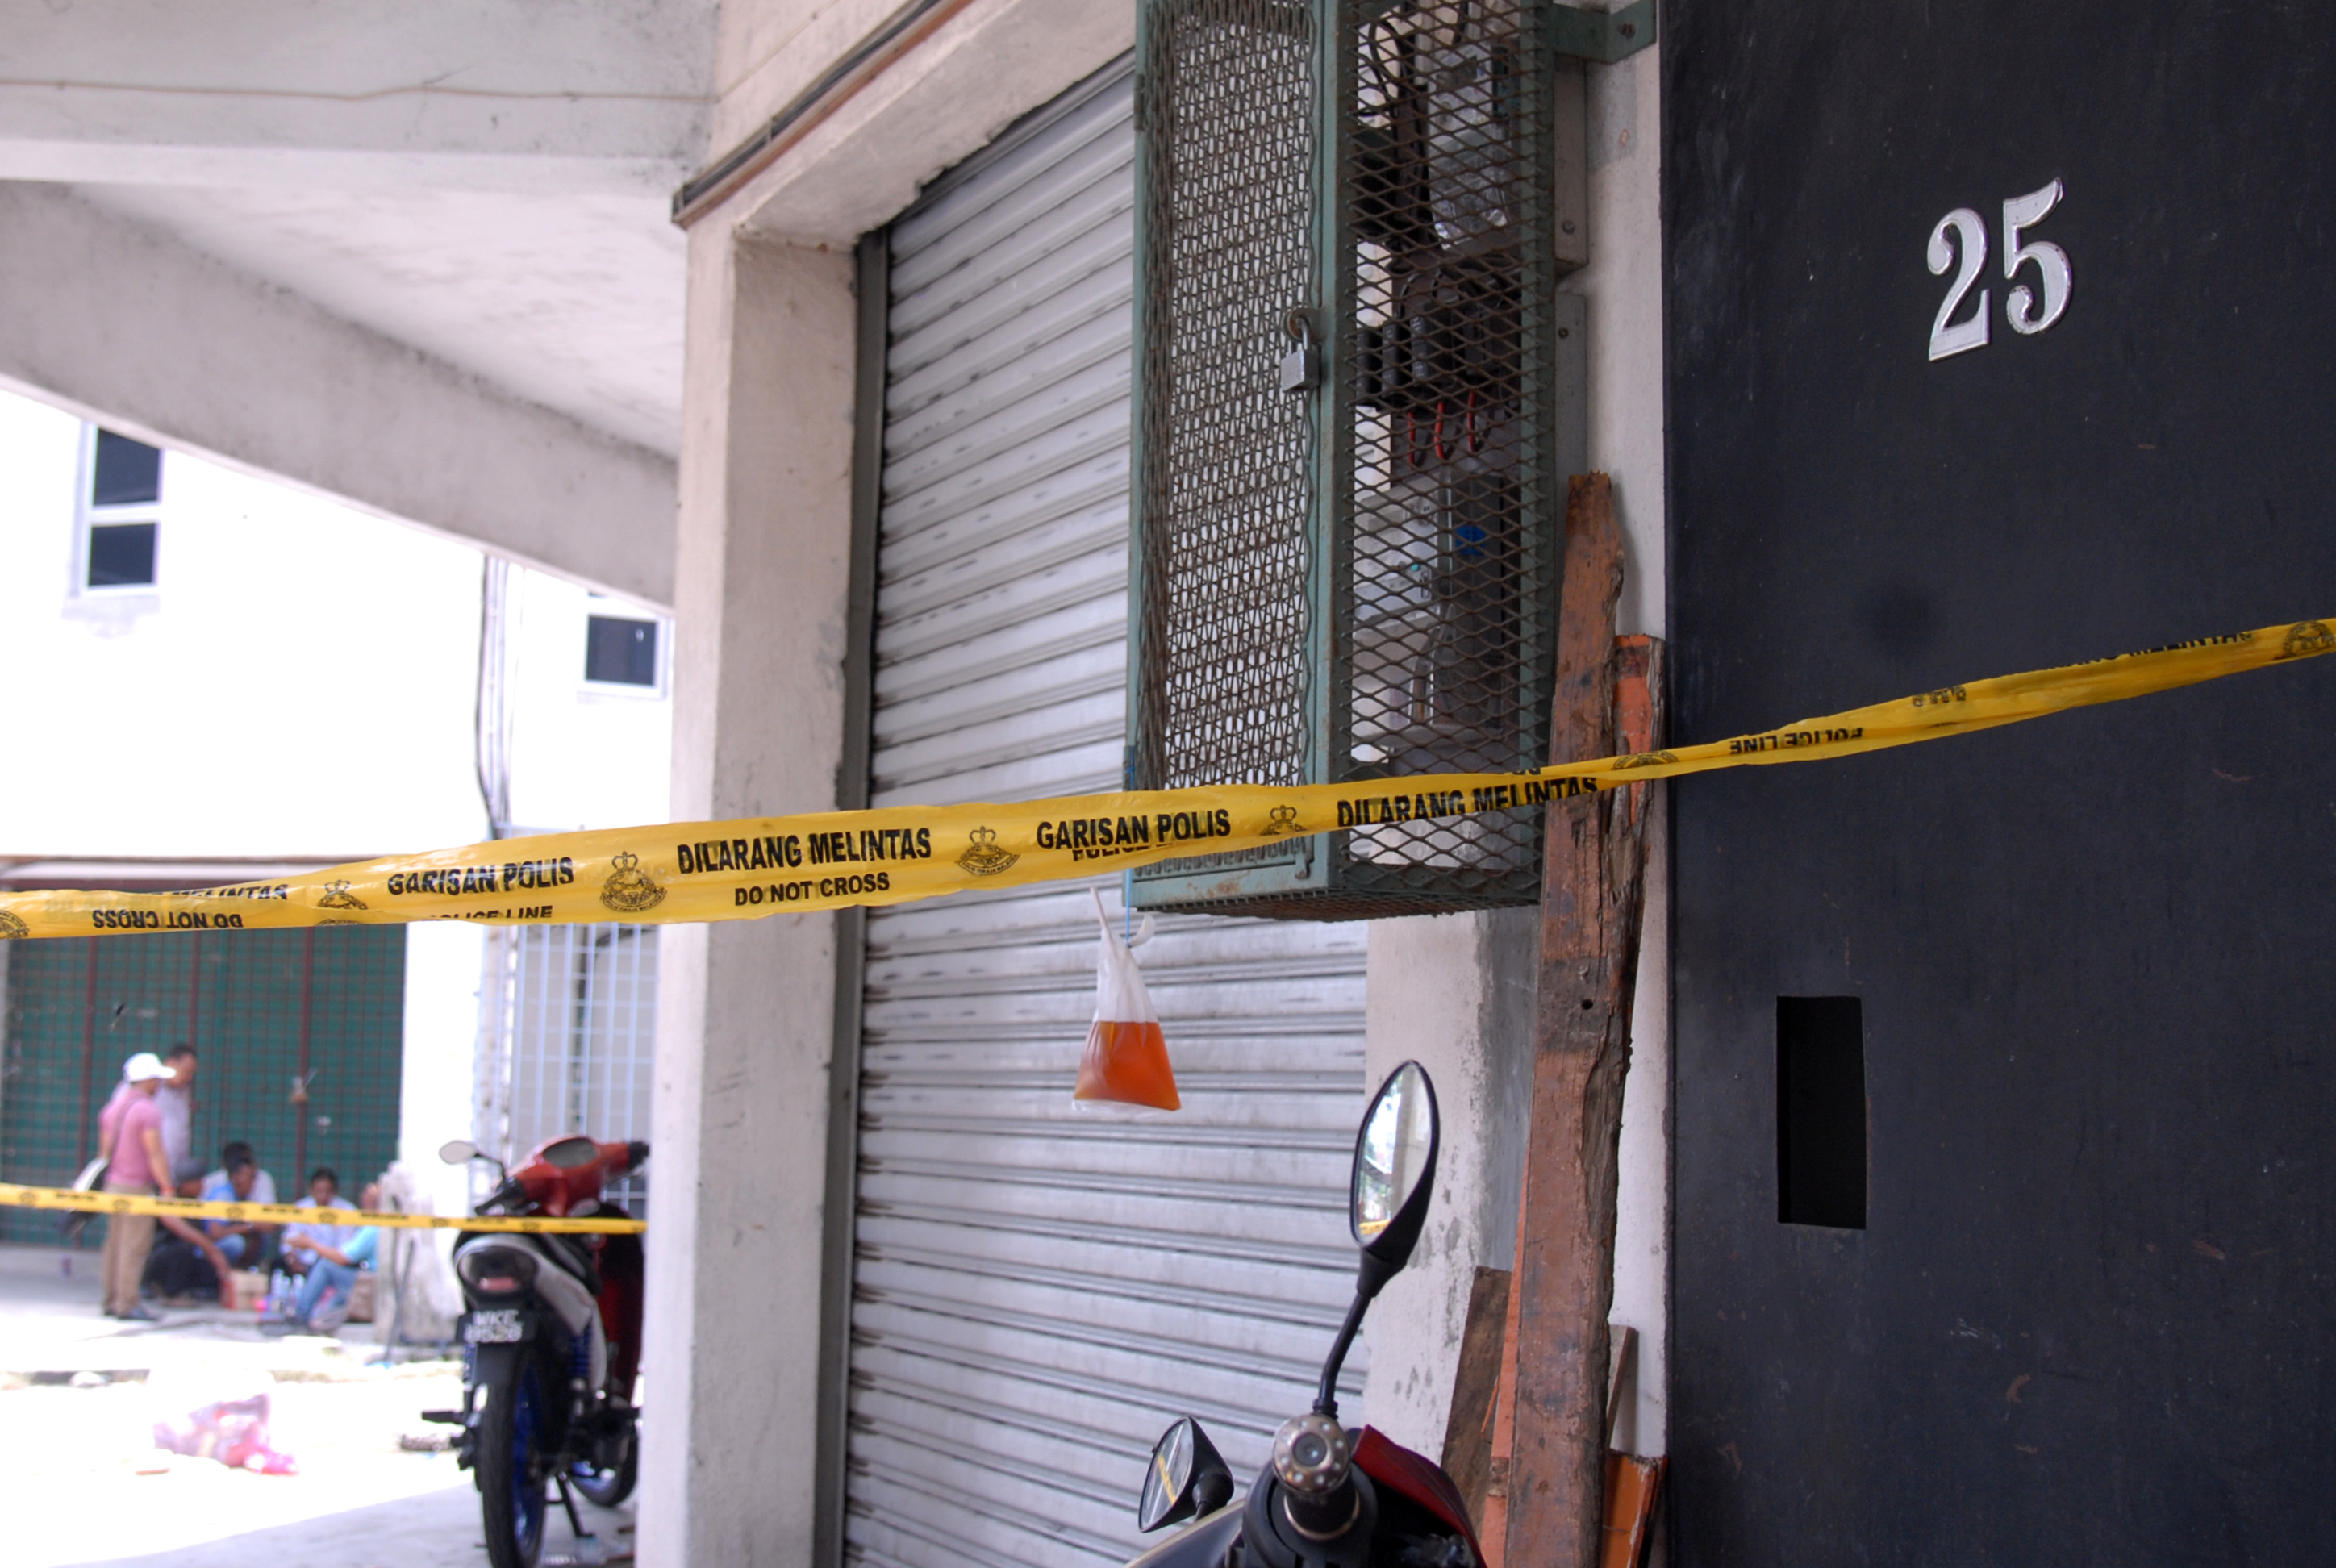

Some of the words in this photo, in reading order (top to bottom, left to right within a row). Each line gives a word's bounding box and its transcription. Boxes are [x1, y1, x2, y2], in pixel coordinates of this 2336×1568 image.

[1927, 177, 2072, 361] 25
[1729, 735, 1778, 755] LINE
[1337, 790, 1466, 828] DILARANG
[1037, 814, 1149, 849] GARISAN
[1157, 807, 1232, 842] POLIS
[677, 834, 801, 874] DILARANG
[807, 827, 932, 865] MELINTAS
[387, 865, 496, 896] GARISAN
[503, 856, 574, 892] POLIS
[734, 885, 764, 906] DO
[770, 880, 814, 903] NOT
[820, 871, 891, 898] CROSS
[91, 909, 159, 929] CROSS
[166, 911, 209, 928] NOT
[214, 912, 244, 928] DO
